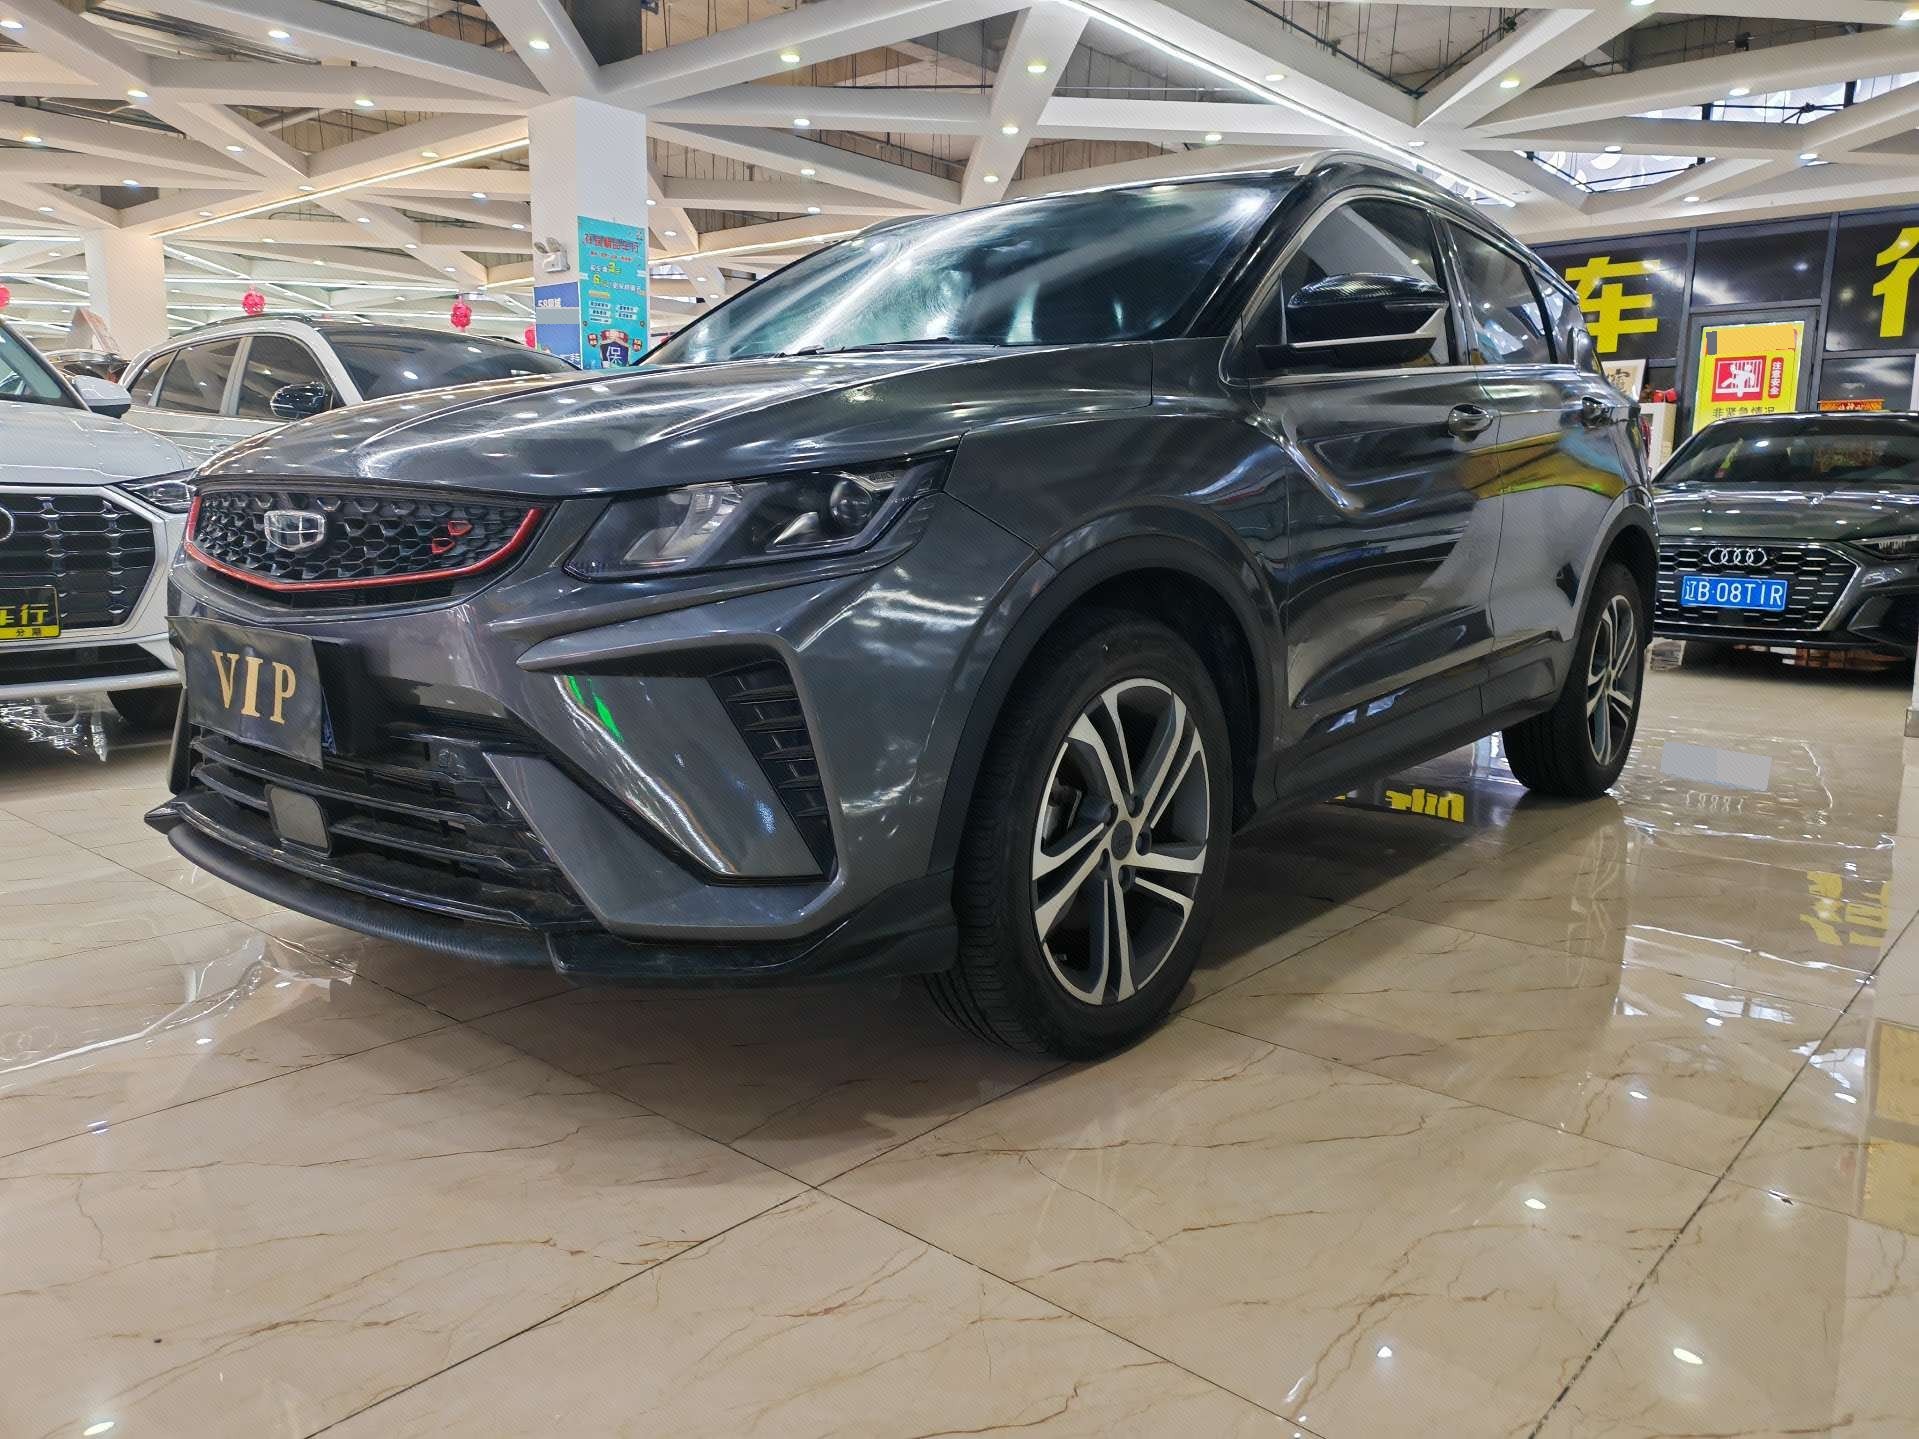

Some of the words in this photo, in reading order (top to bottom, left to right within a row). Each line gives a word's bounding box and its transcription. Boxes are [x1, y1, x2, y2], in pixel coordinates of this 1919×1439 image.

[1769, 361, 1782, 395] 注意安全
[211, 650, 296, 724] VIP
